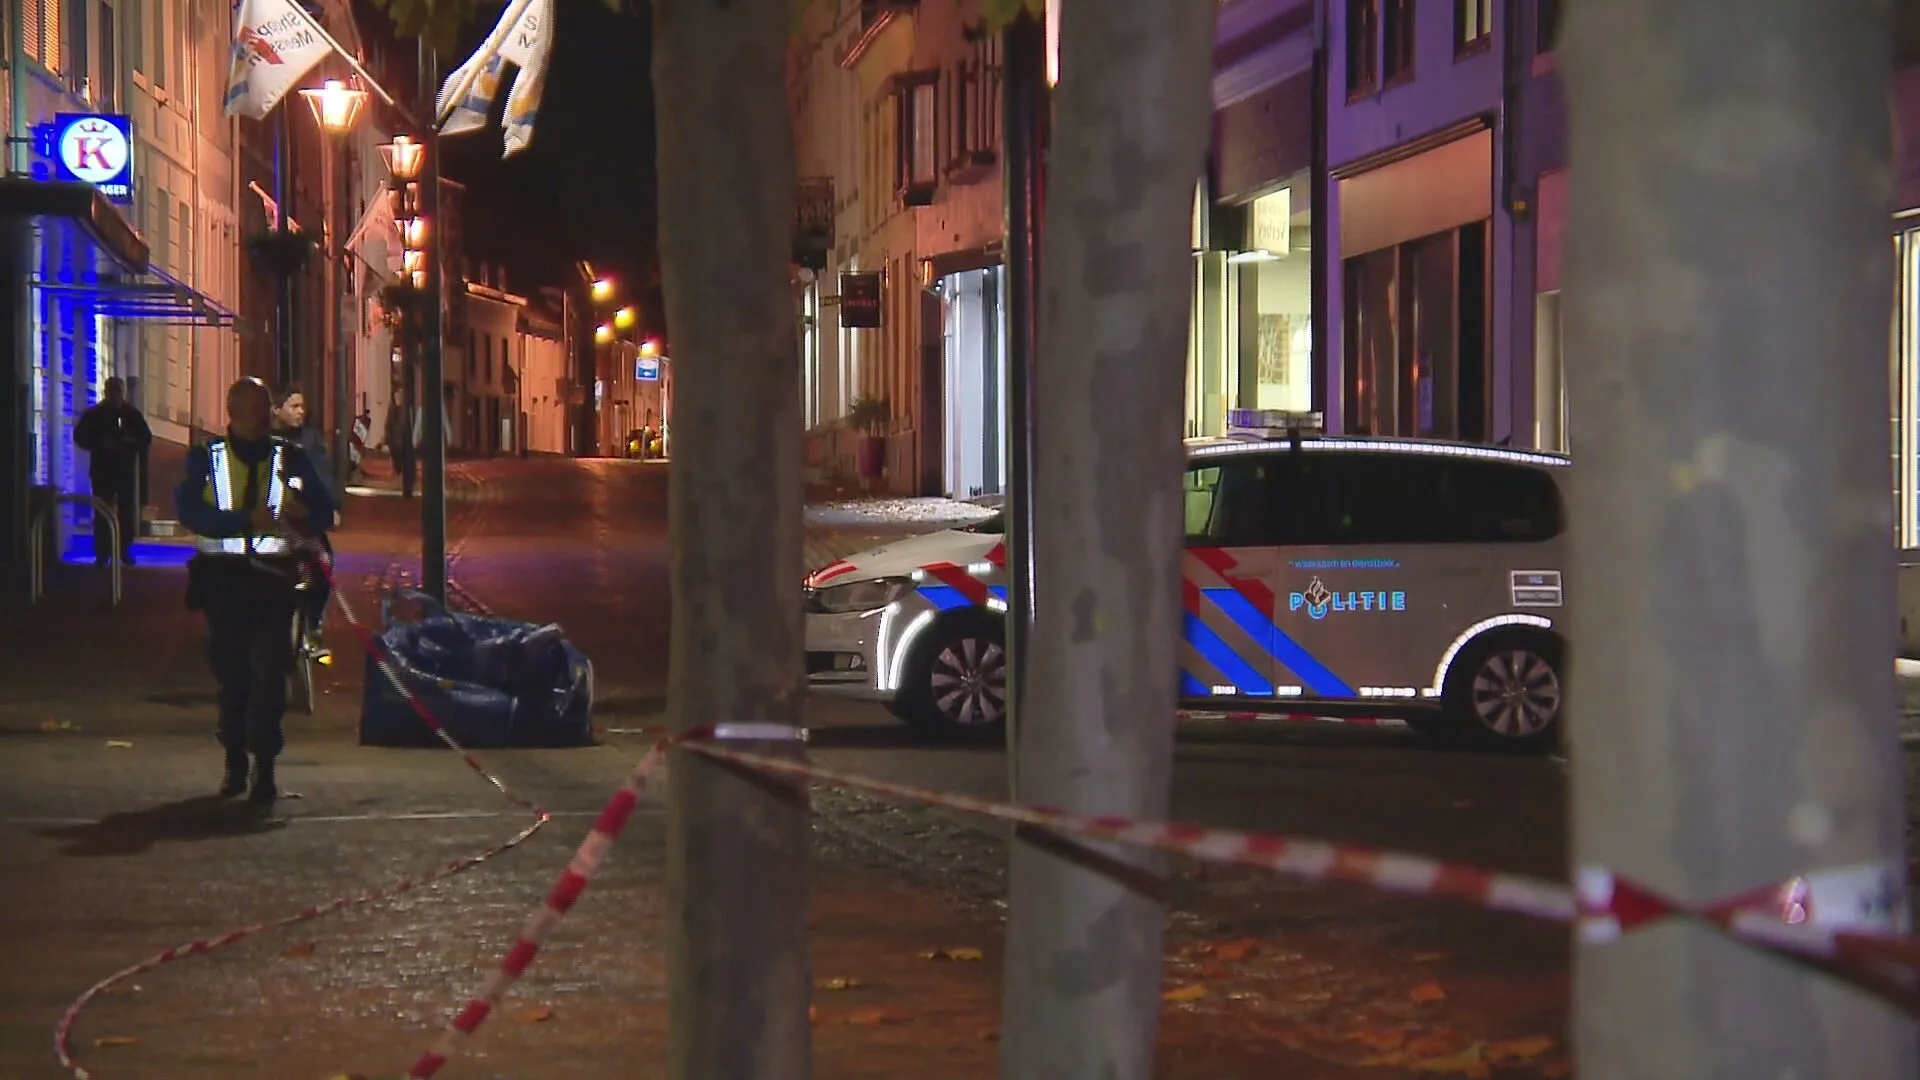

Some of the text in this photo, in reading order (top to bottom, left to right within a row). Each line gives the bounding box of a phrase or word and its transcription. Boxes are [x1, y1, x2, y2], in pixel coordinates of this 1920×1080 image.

[73, 136, 114, 170] K
[99, 184, 127, 196] AGER
[1289, 590, 1406, 619] POLITIE
